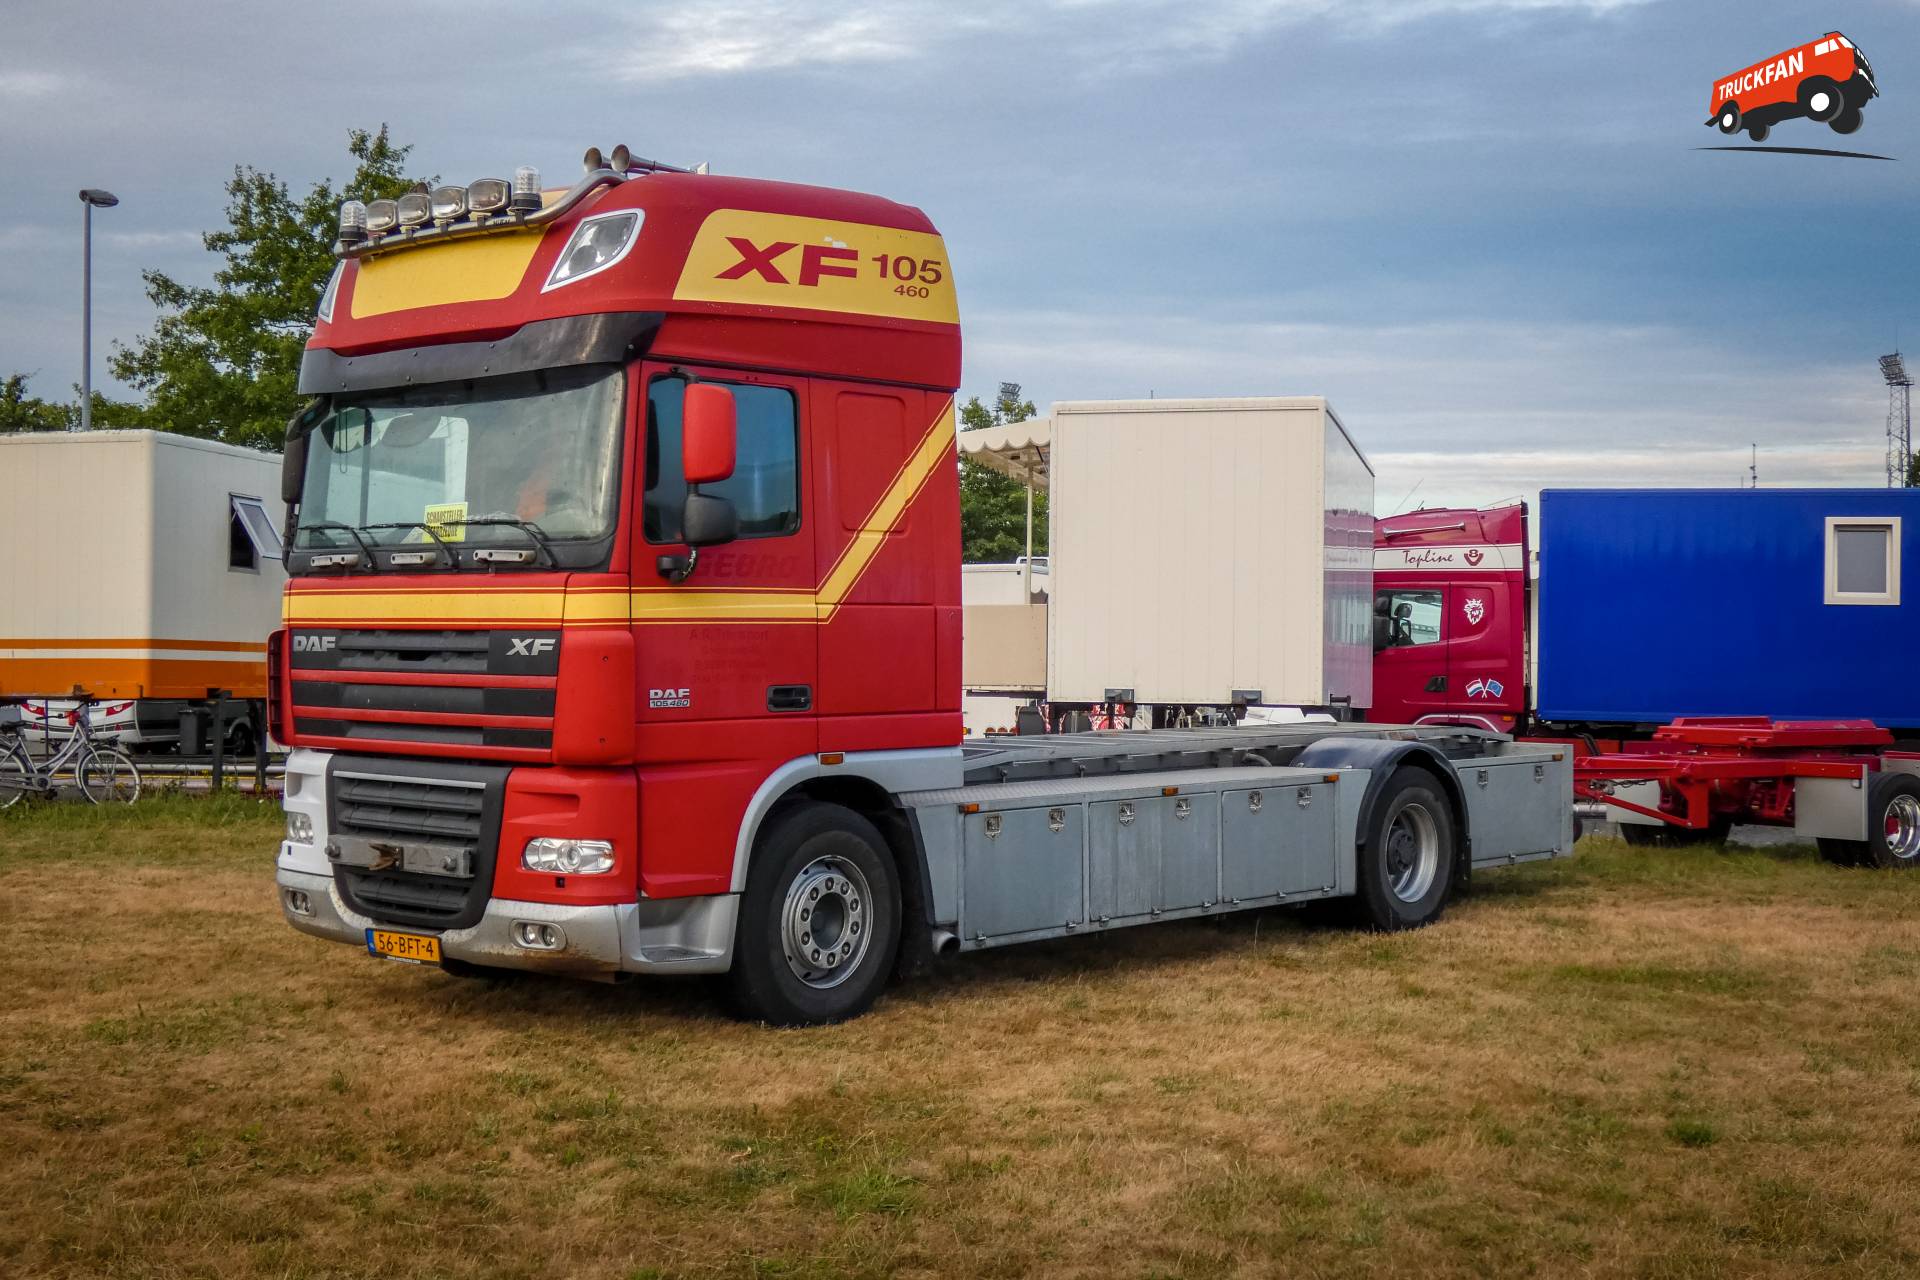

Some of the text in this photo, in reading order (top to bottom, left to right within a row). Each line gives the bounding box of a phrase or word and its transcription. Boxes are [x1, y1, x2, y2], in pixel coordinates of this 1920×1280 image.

[713, 237, 942, 287] XF 105
[894, 285, 930, 298] 460
[1403, 549, 1454, 568] Topline
[293, 636, 336, 652] DAF
[506, 638, 556, 656] XF
[650, 688, 690, 698] DAF
[379, 934, 434, 957] 56-BFT-4
